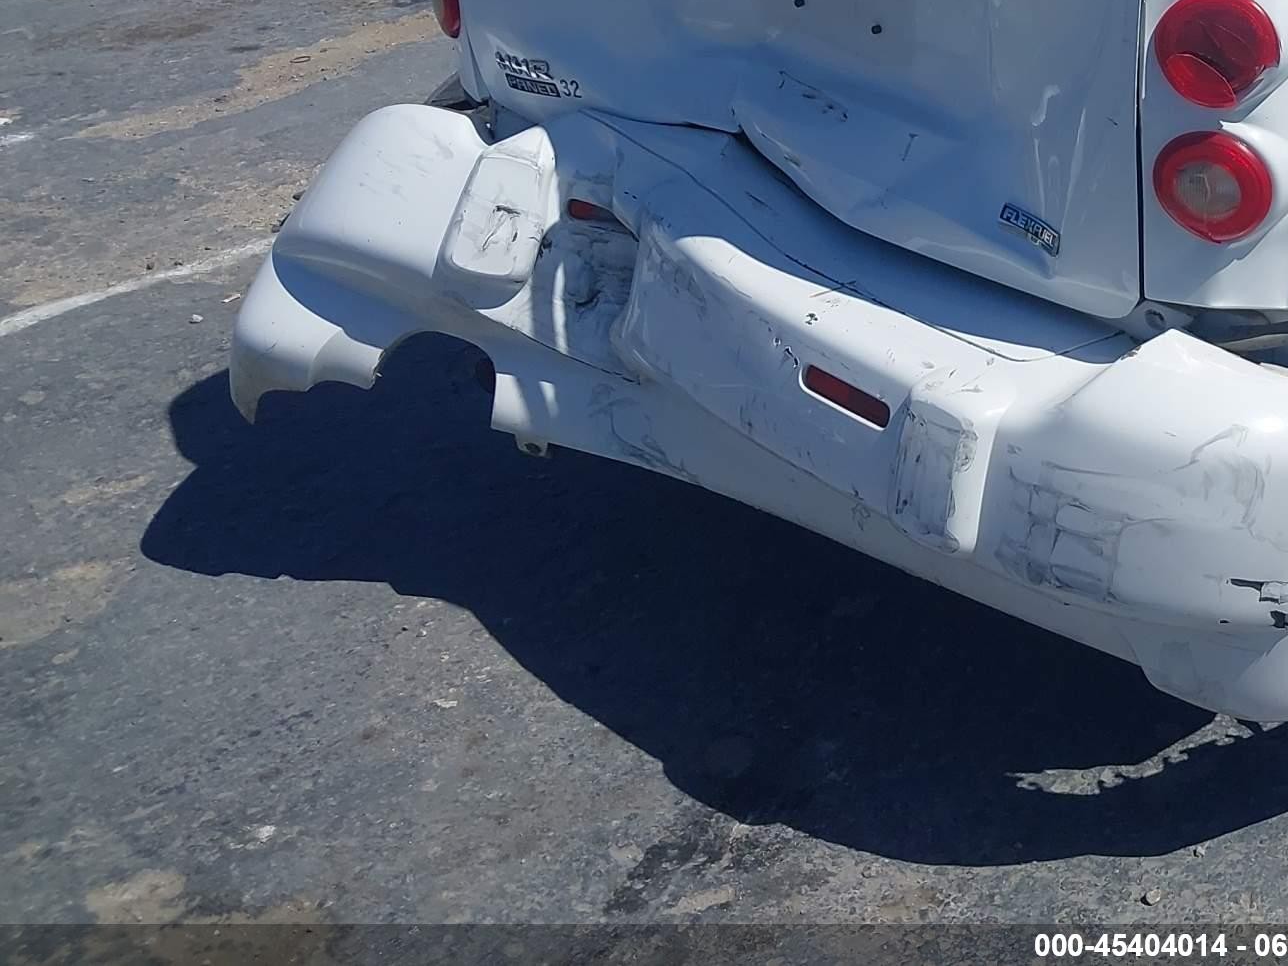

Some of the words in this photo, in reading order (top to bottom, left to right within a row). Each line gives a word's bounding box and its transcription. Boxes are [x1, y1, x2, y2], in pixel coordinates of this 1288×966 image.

[507, 75, 558, 96] PANEL
[559, 78, 583, 99] 32
[1002, 206, 1056, 247] FLEXFUEL
